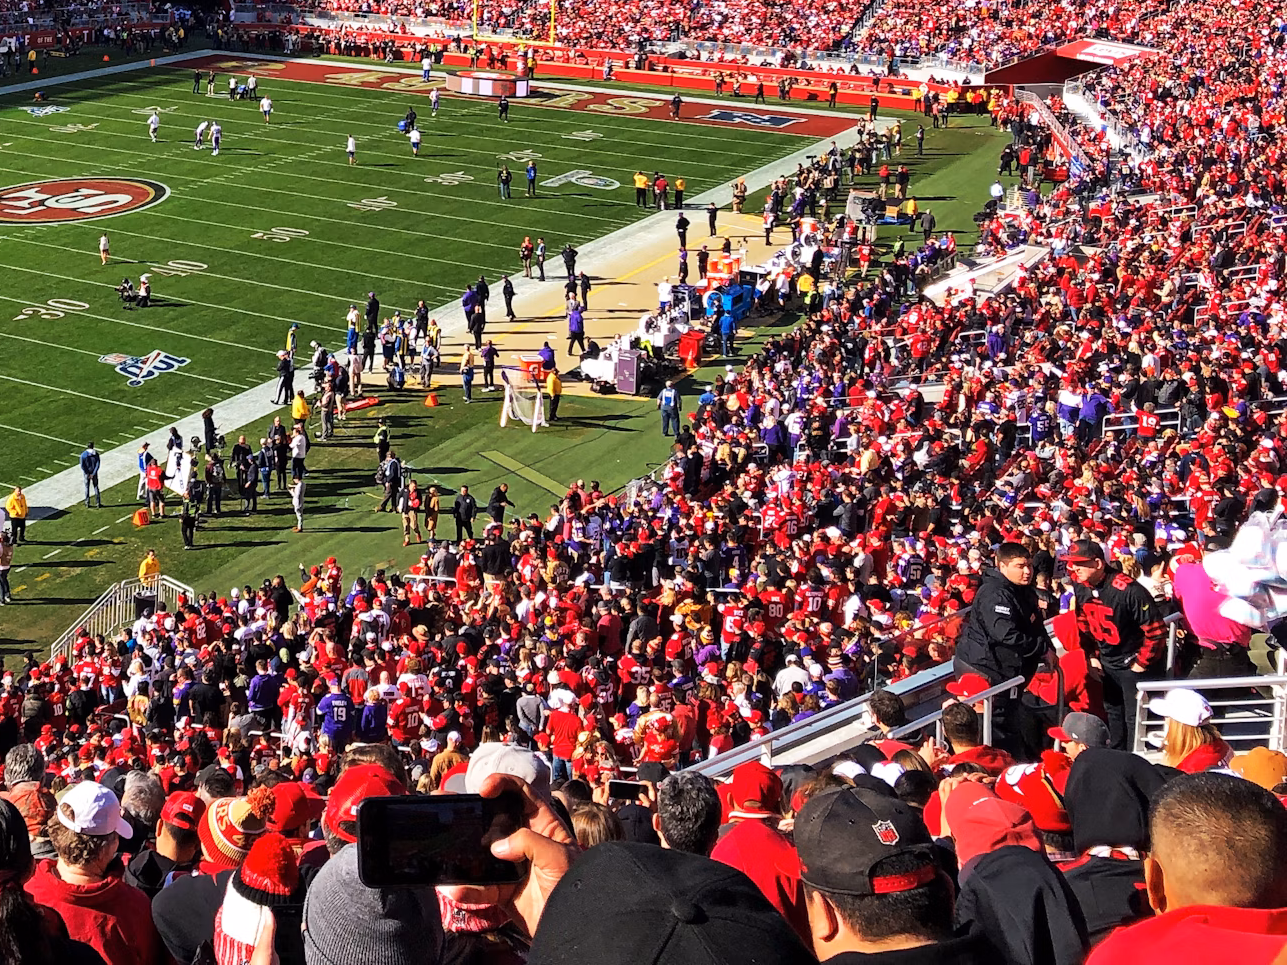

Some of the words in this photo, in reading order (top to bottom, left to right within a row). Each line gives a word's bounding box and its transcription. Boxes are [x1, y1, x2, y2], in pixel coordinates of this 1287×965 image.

[149, 259, 209, 277] 40
[22, 298, 90, 319] 30
[786, 521, 798, 535] 16
[768, 603, 783, 618] 80
[806, 597, 822, 612] 10
[1082, 603, 1120, 645] 85
[630, 665, 651, 685] 35
[52, 703, 63, 716] 10
[332, 708, 347, 722] 19
[406, 712, 419, 728] 10
